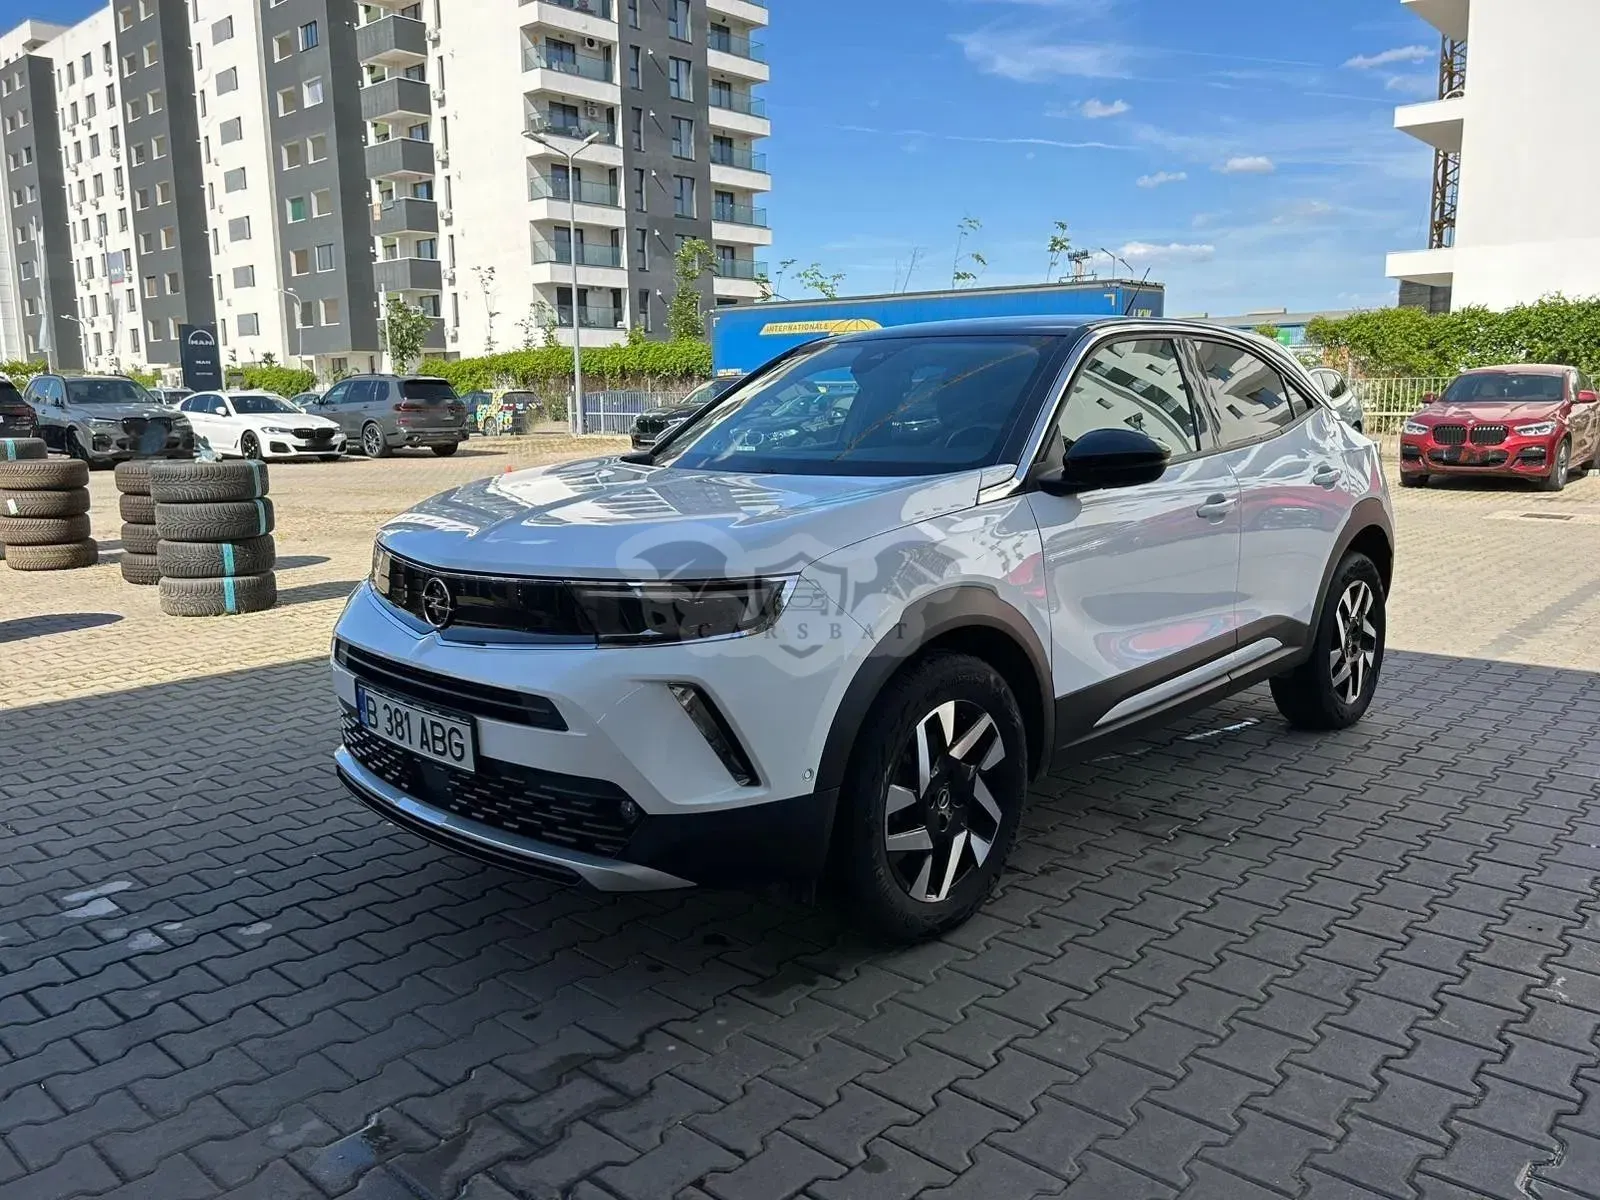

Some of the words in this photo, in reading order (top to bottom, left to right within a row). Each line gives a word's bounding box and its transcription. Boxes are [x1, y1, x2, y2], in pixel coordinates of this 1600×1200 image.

[766, 323, 829, 334] INTERNATIONALE
[366, 695, 379, 729] B
[382, 703, 413, 745] 381
[419, 717, 466, 762] ABG
